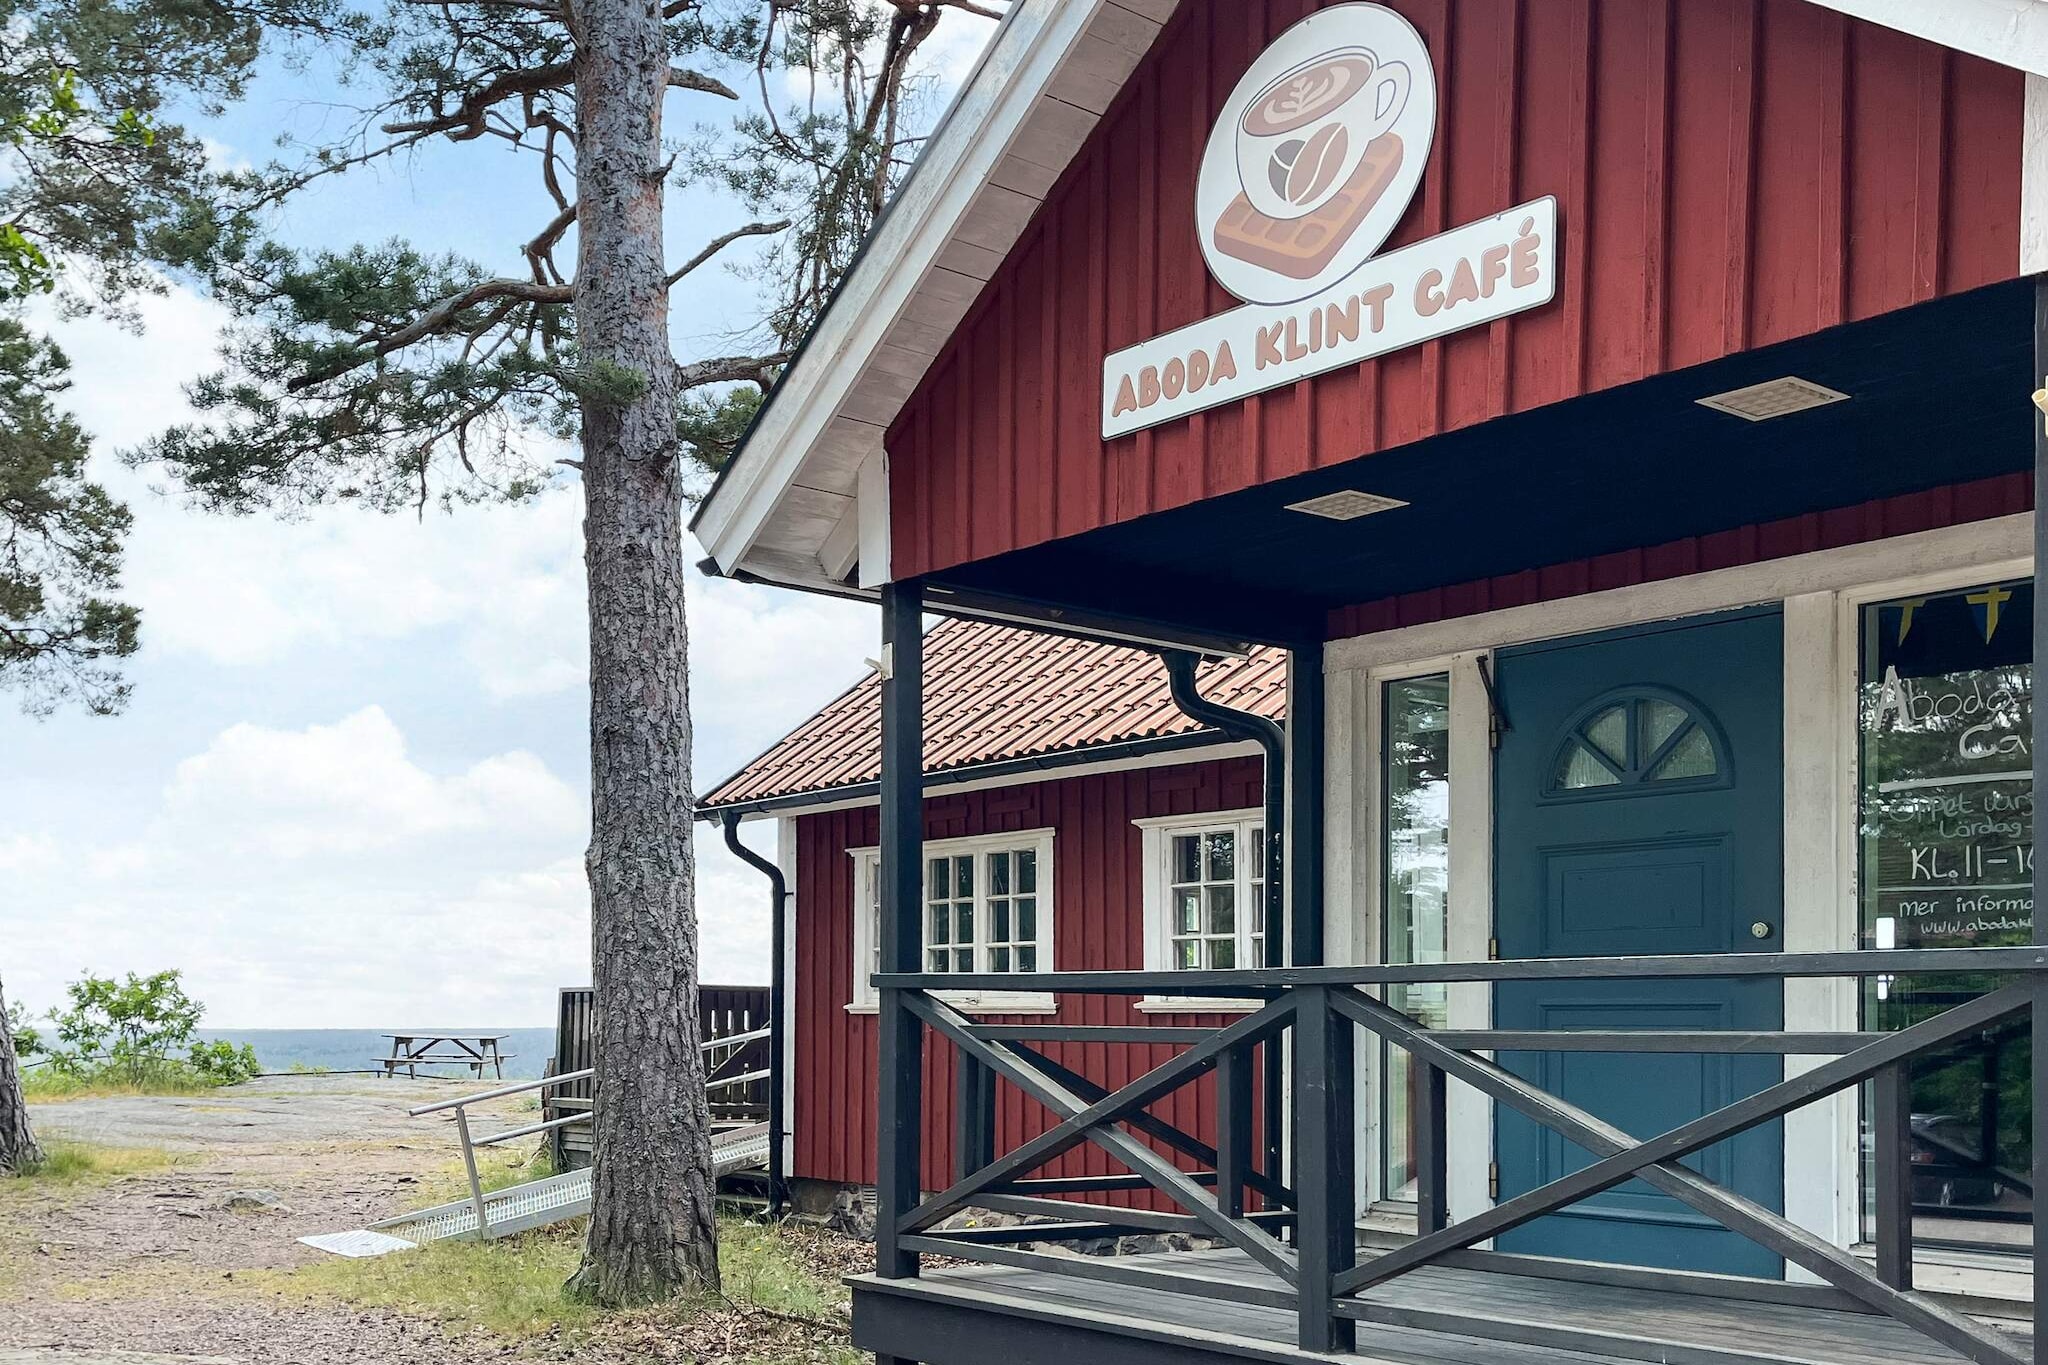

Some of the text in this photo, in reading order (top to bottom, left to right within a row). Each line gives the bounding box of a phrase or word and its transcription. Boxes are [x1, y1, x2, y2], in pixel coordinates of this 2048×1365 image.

[1111, 216, 1542, 418] ABODA KLINT CAFÉ
[1873, 665, 2016, 729] Aboda
[1959, 722, 2032, 760] Ca
[1888, 791, 1974, 823] Öppet
[1899, 901, 1939, 918] mer
